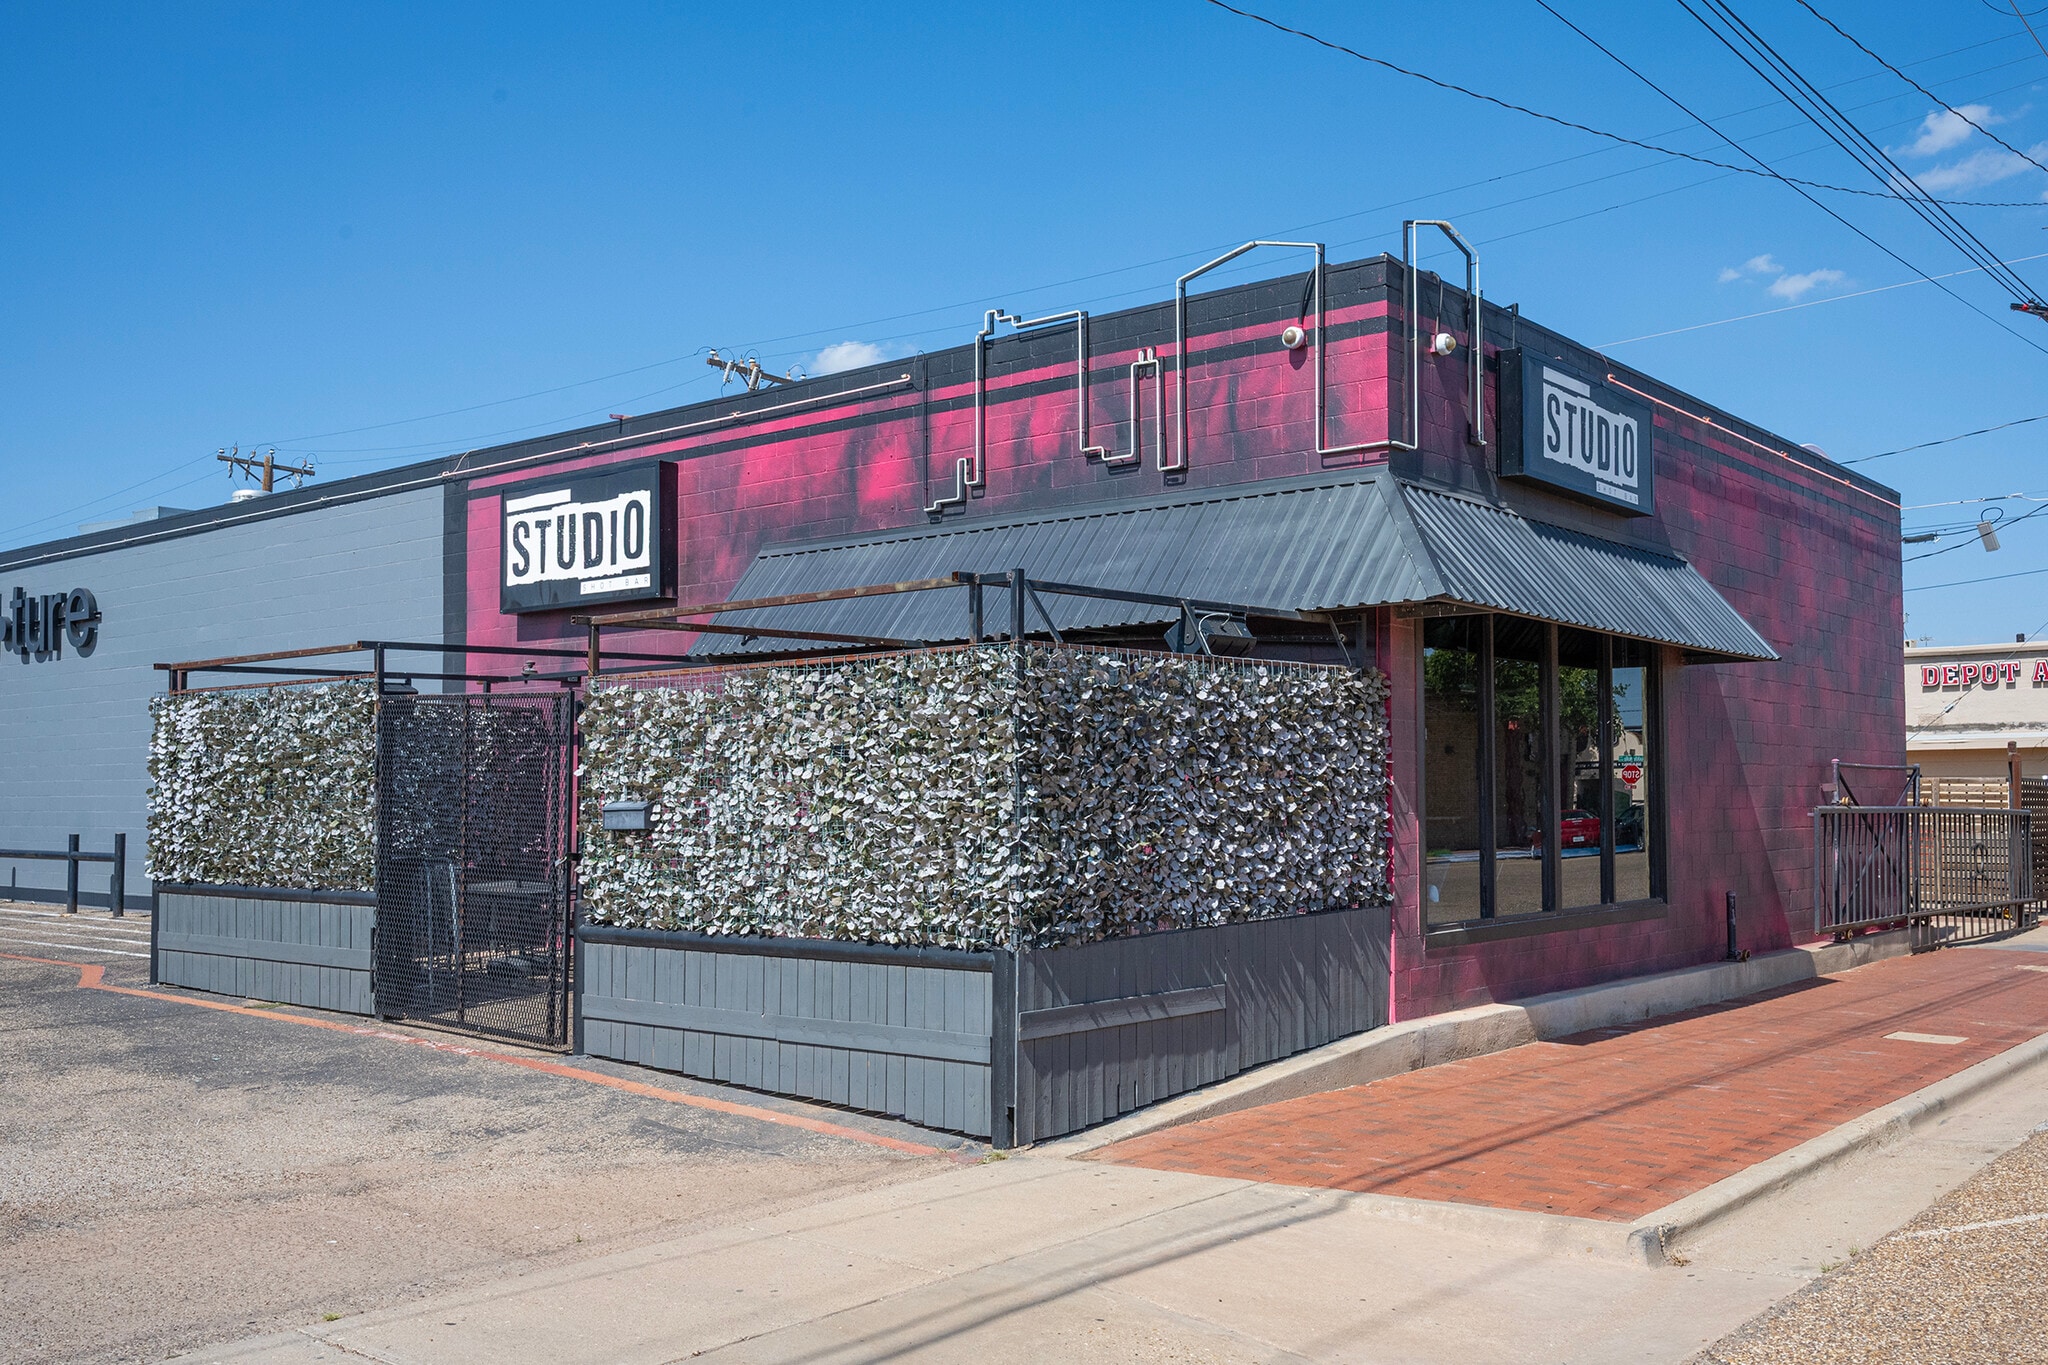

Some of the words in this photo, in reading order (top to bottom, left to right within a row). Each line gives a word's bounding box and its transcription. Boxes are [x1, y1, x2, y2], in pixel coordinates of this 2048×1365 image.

[1547, 393, 1635, 479] STUDIO
[512, 499, 645, 577] STUDIO
[582, 580, 612, 592] SHOT
[624, 576, 649, 587] BAR
[0, 587, 98, 657] ture
[1921, 661, 2020, 688] DEPOT
